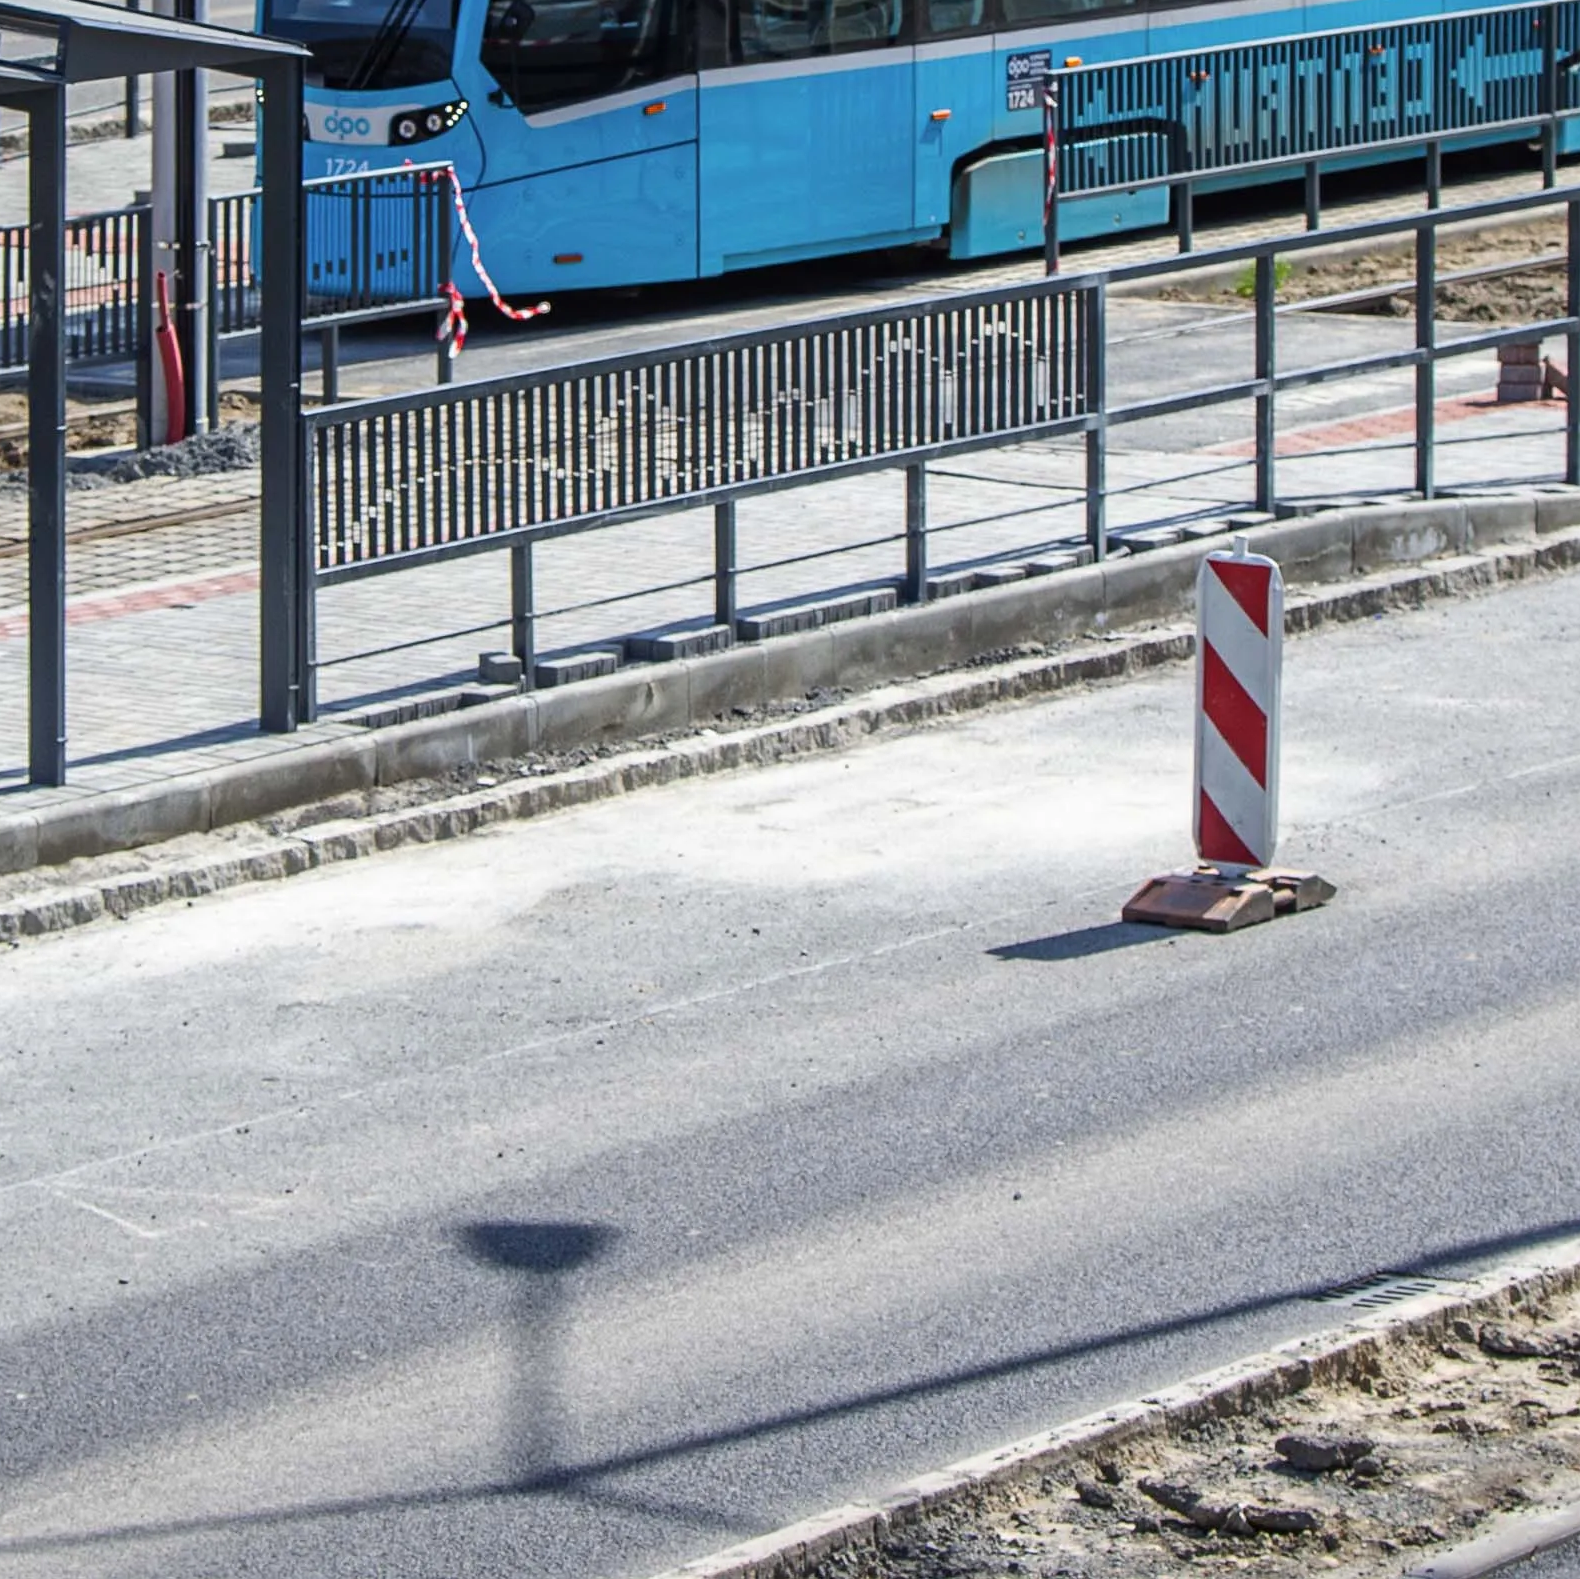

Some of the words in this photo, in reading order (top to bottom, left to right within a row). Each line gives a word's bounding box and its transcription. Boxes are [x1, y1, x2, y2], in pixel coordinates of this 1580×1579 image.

[1008, 55, 1030, 79] dpo
[1008, 89, 1035, 110] 1724
[324, 108, 370, 141] dpo
[325, 157, 370, 177] 1724
